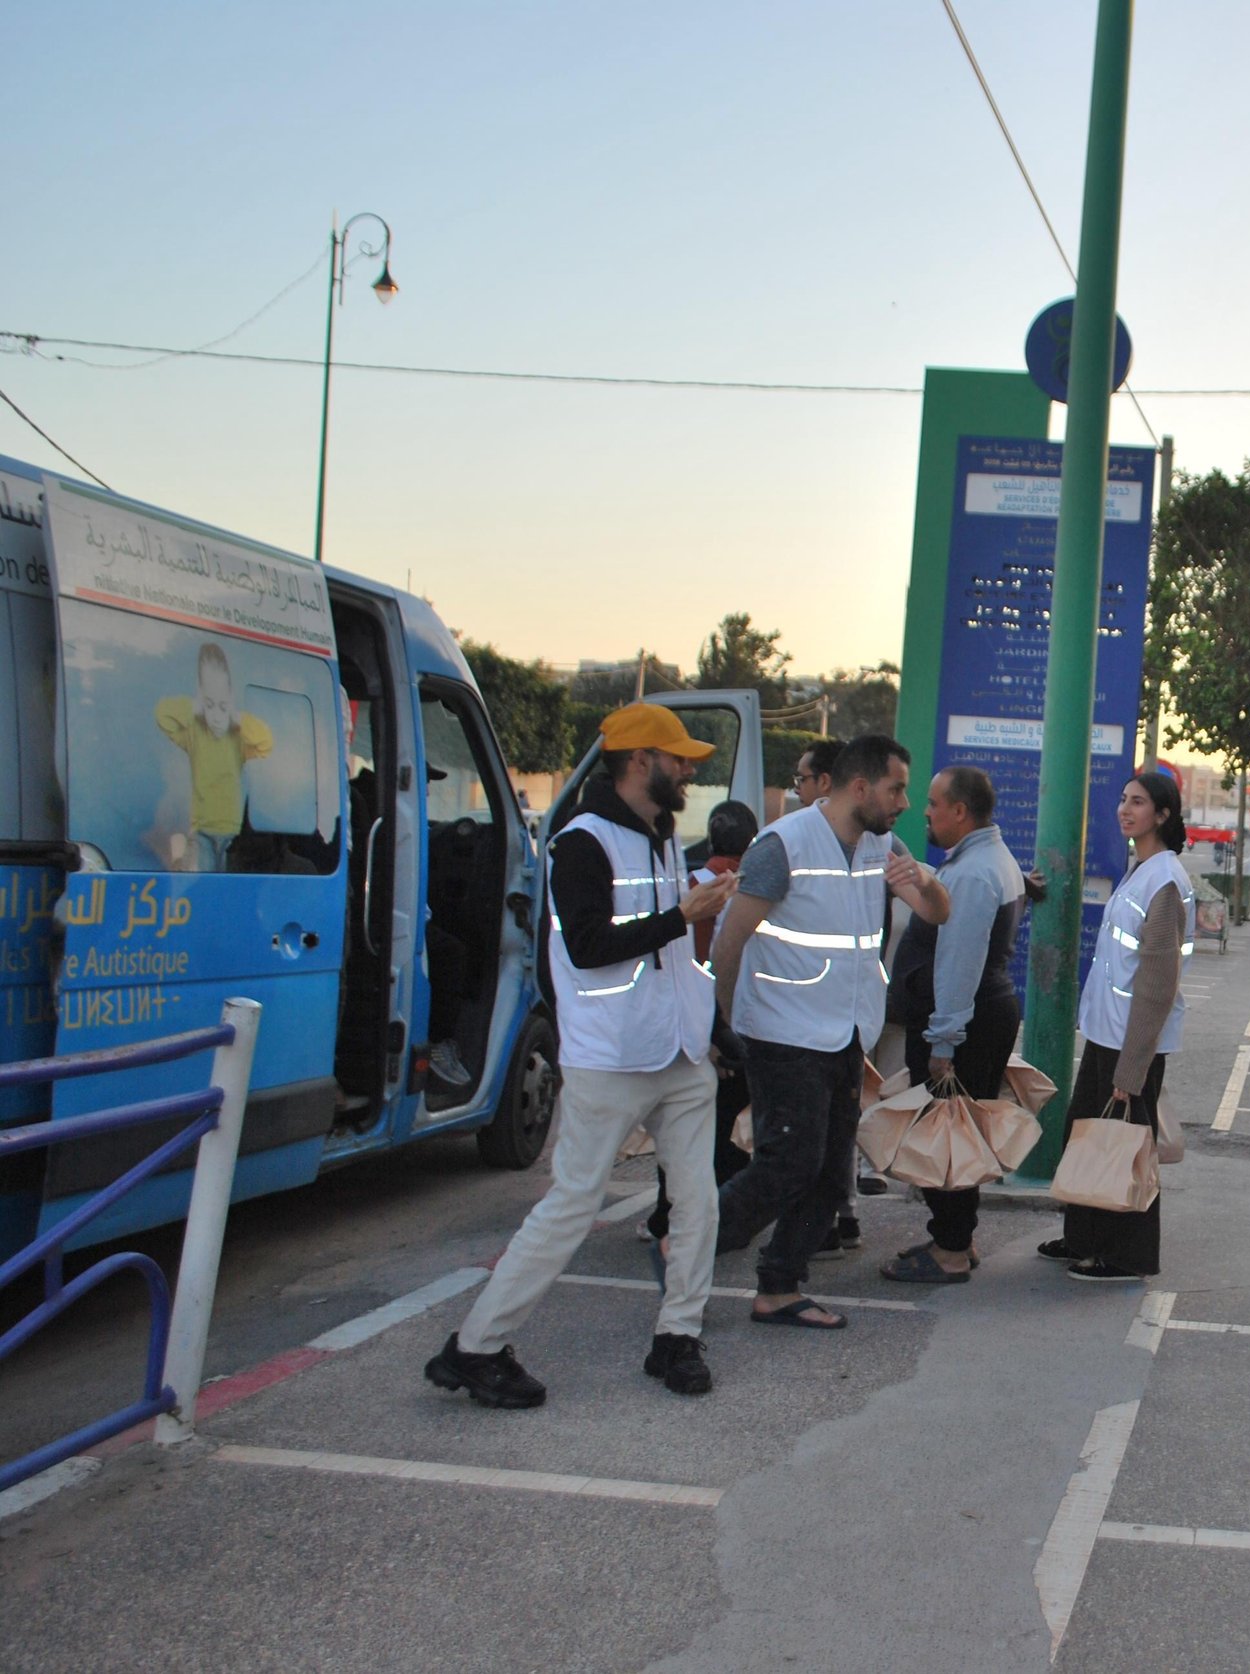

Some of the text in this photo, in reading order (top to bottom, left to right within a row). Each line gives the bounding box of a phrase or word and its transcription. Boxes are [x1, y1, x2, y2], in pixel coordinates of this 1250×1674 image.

[83, 513, 153, 567] البشرية
[142, 583, 195, 612] Nationale
[301, 628, 333, 646] Humain
[964, 735, 999, 745] SERVICES
[119, 878, 191, 938] مركز
[84, 946, 189, 984] Autistique
